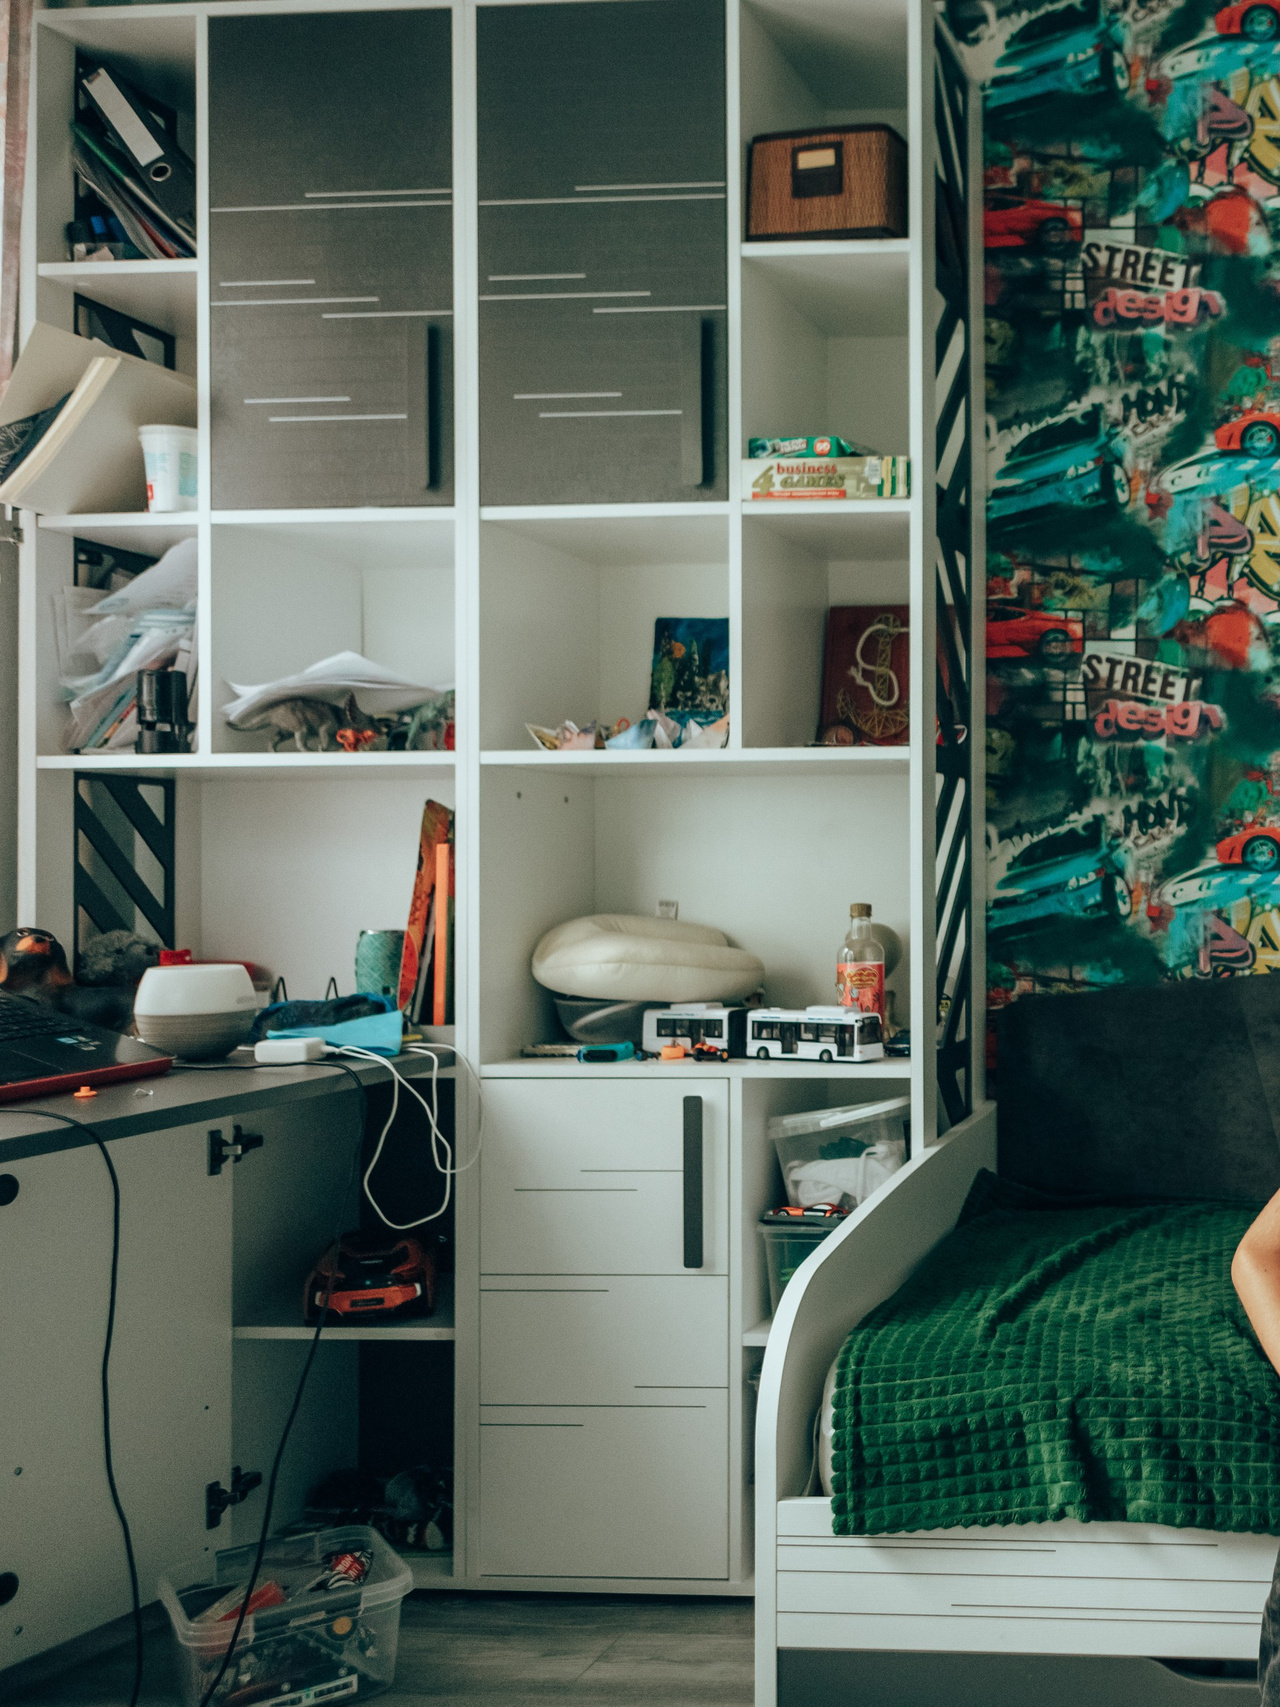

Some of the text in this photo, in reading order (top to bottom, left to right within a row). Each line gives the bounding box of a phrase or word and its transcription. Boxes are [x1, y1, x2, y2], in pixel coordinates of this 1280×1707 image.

[1083, 243, 1199, 287] STREET
[752, 465, 776, 494] 4
[776, 462, 837, 475] business
[1084, 656, 1200, 700] STREET
